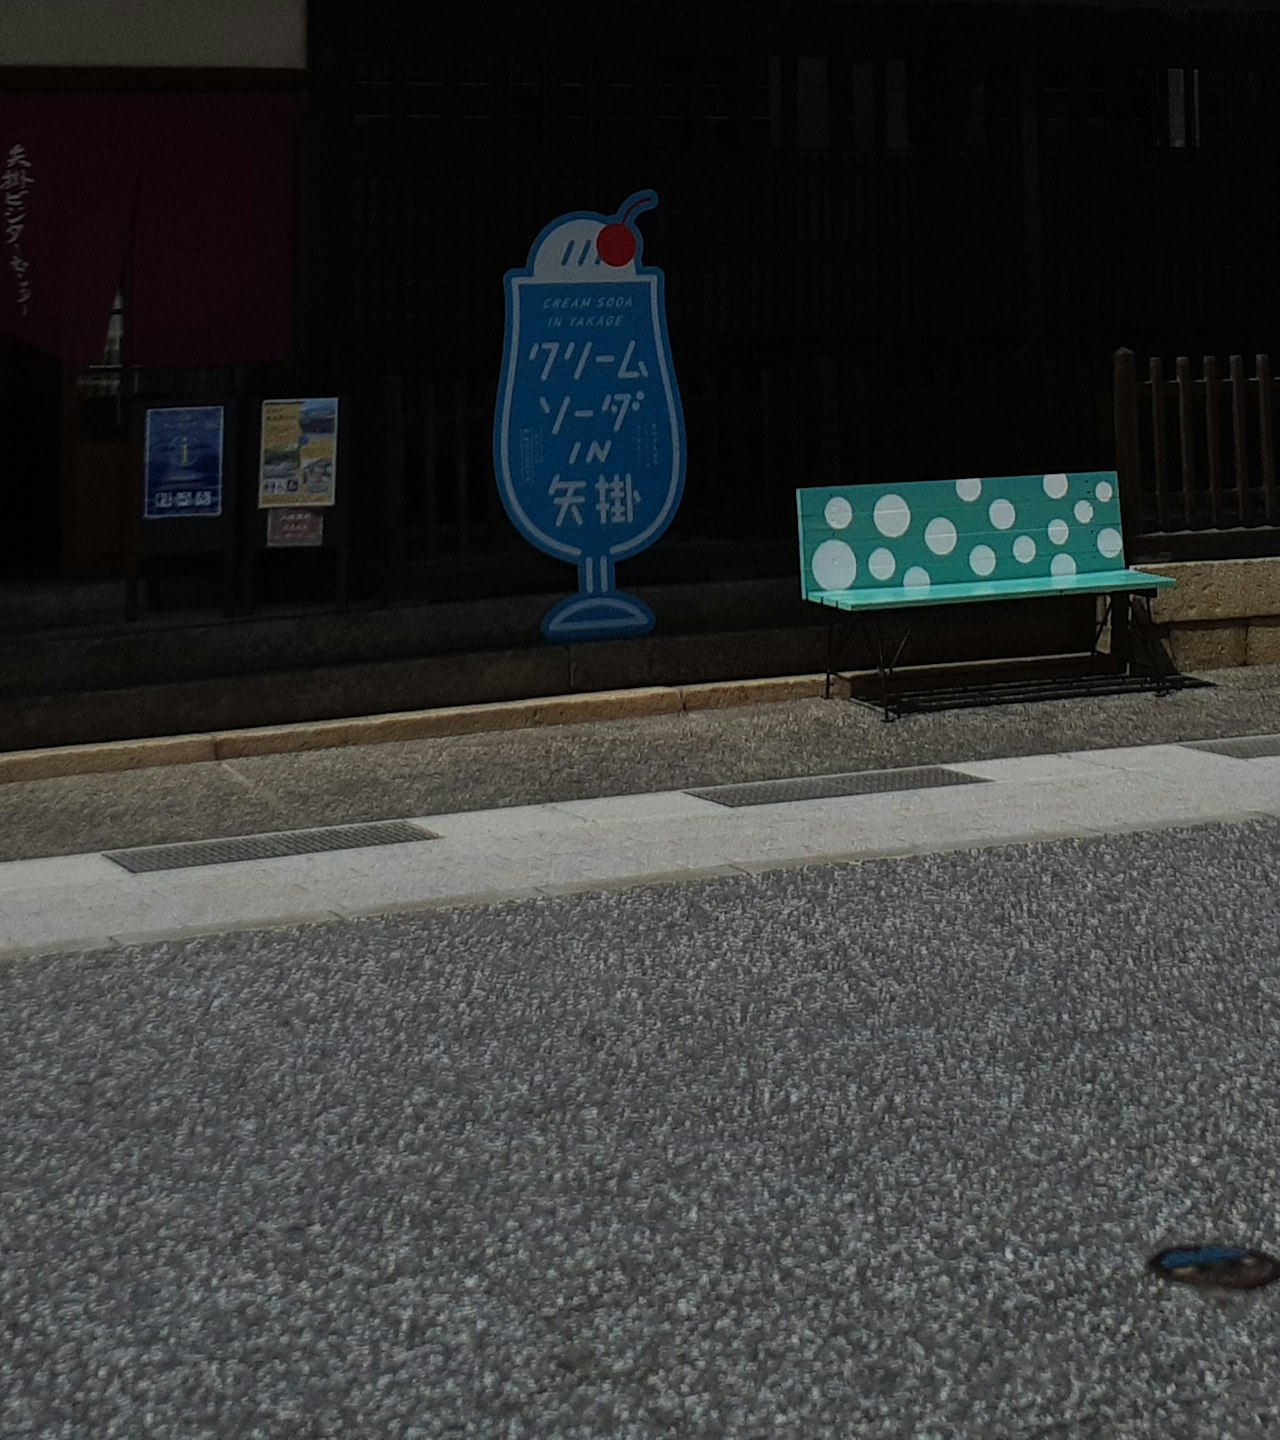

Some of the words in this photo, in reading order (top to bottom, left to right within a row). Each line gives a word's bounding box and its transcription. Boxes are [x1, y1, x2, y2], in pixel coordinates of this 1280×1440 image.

[542, 297, 592, 309] CREAM
[596, 296, 633, 308] SODA
[547, 316, 563, 328] IN
[569, 315, 624, 327] YAKAGE
[529, 339, 649, 382] クリーム
[538, 391, 645, 435] ソーダ
[568, 440, 612, 466] IN
[546, 472, 642, 529] 矢掛
